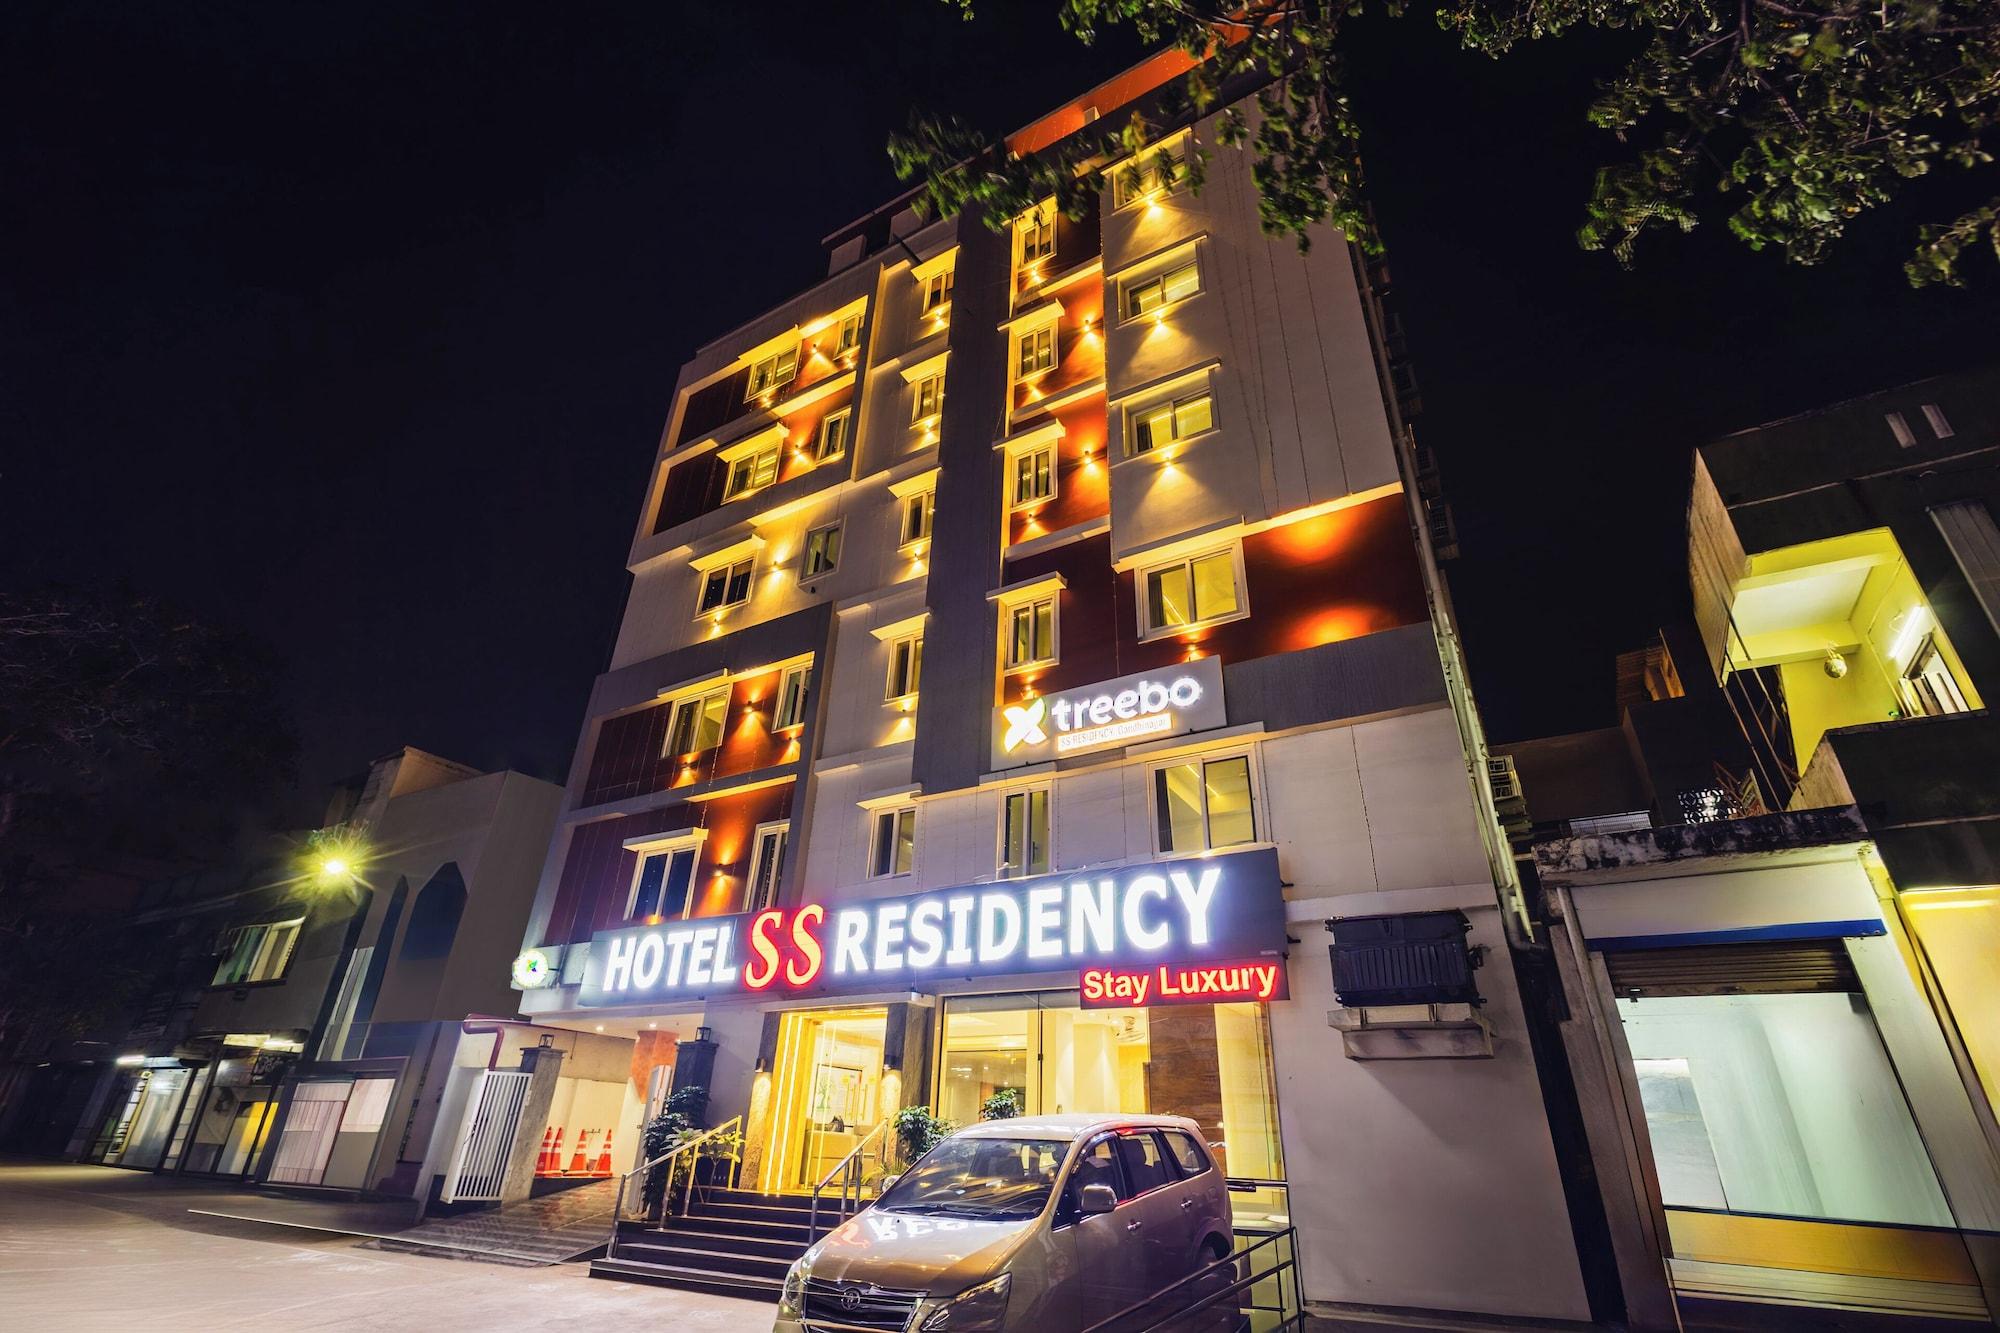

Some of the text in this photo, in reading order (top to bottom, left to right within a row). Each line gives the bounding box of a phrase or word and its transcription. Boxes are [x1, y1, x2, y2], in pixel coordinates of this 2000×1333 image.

[1052, 677, 1201, 731] treebo
[603, 868, 1222, 992] HOTEL SS RESIDENCY
[1084, 966, 1276, 1004] Stay Luxury
